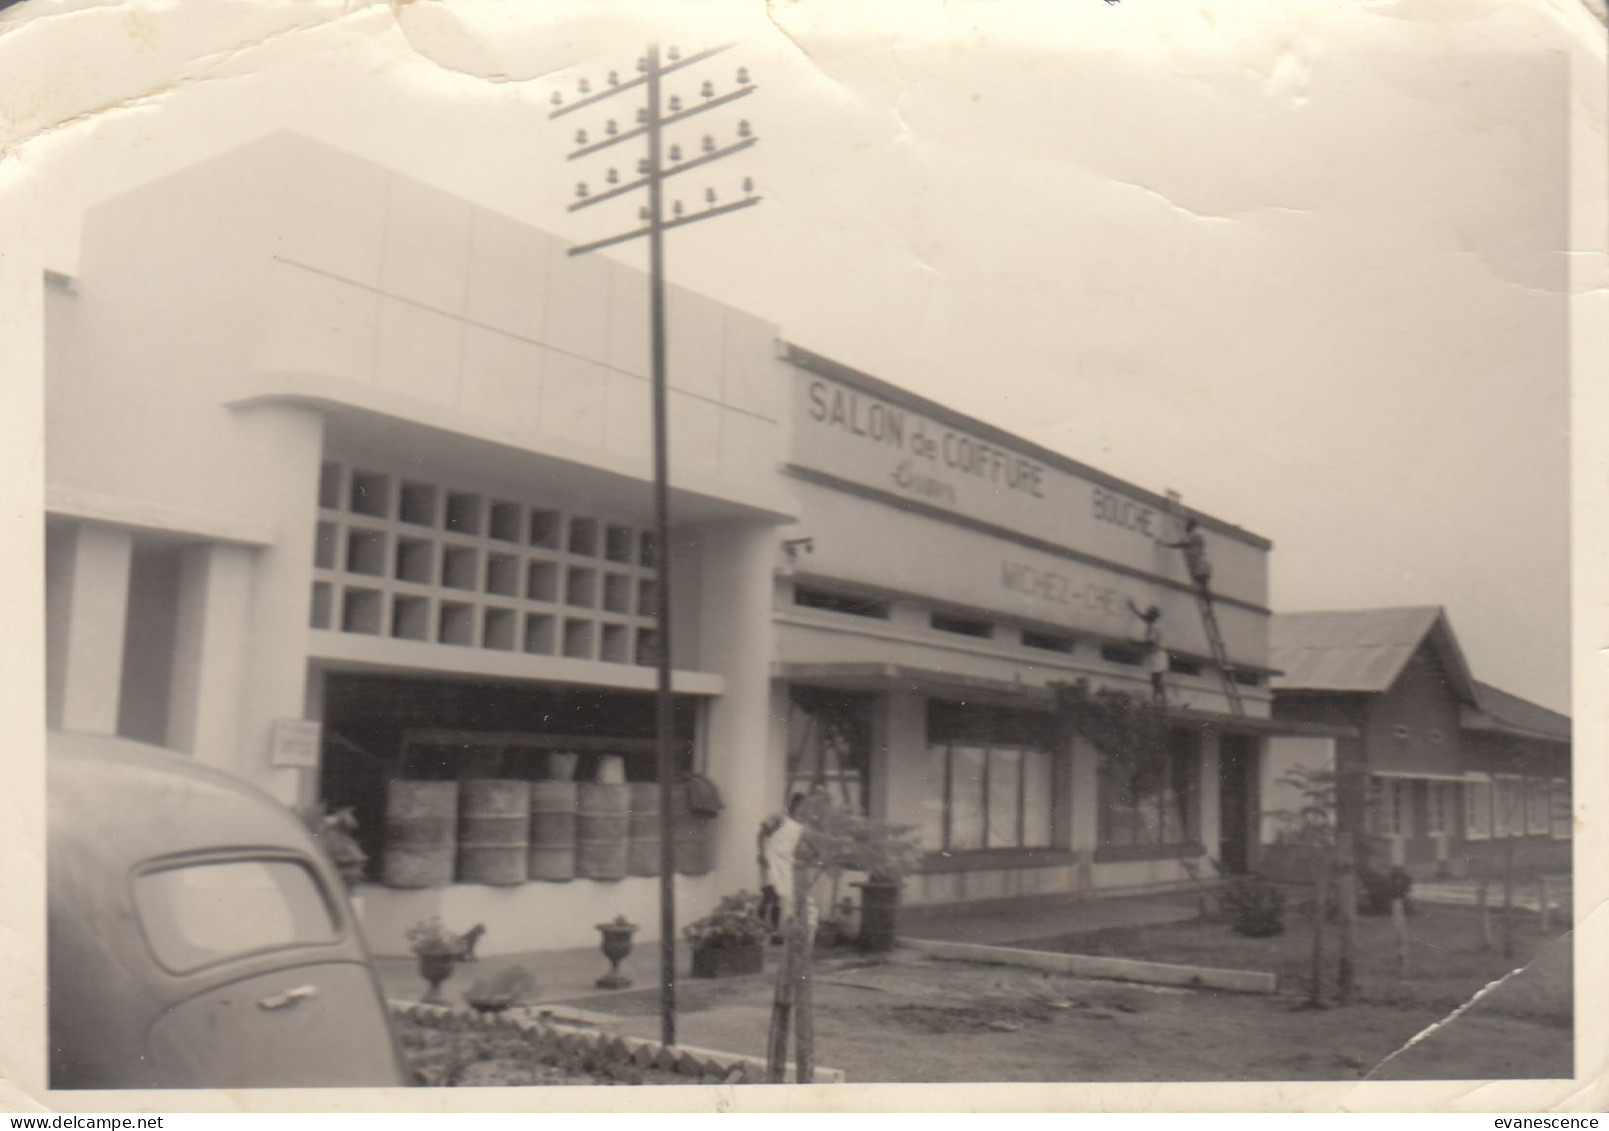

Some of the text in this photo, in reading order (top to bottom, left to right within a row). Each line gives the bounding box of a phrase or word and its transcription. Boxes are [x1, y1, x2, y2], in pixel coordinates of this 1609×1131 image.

[808, 380, 905, 449] SALON
[910, 421, 937, 460] de
[942, 432, 1045, 499] COIFFURE
[1091, 487, 1156, 538] BOUCHE
